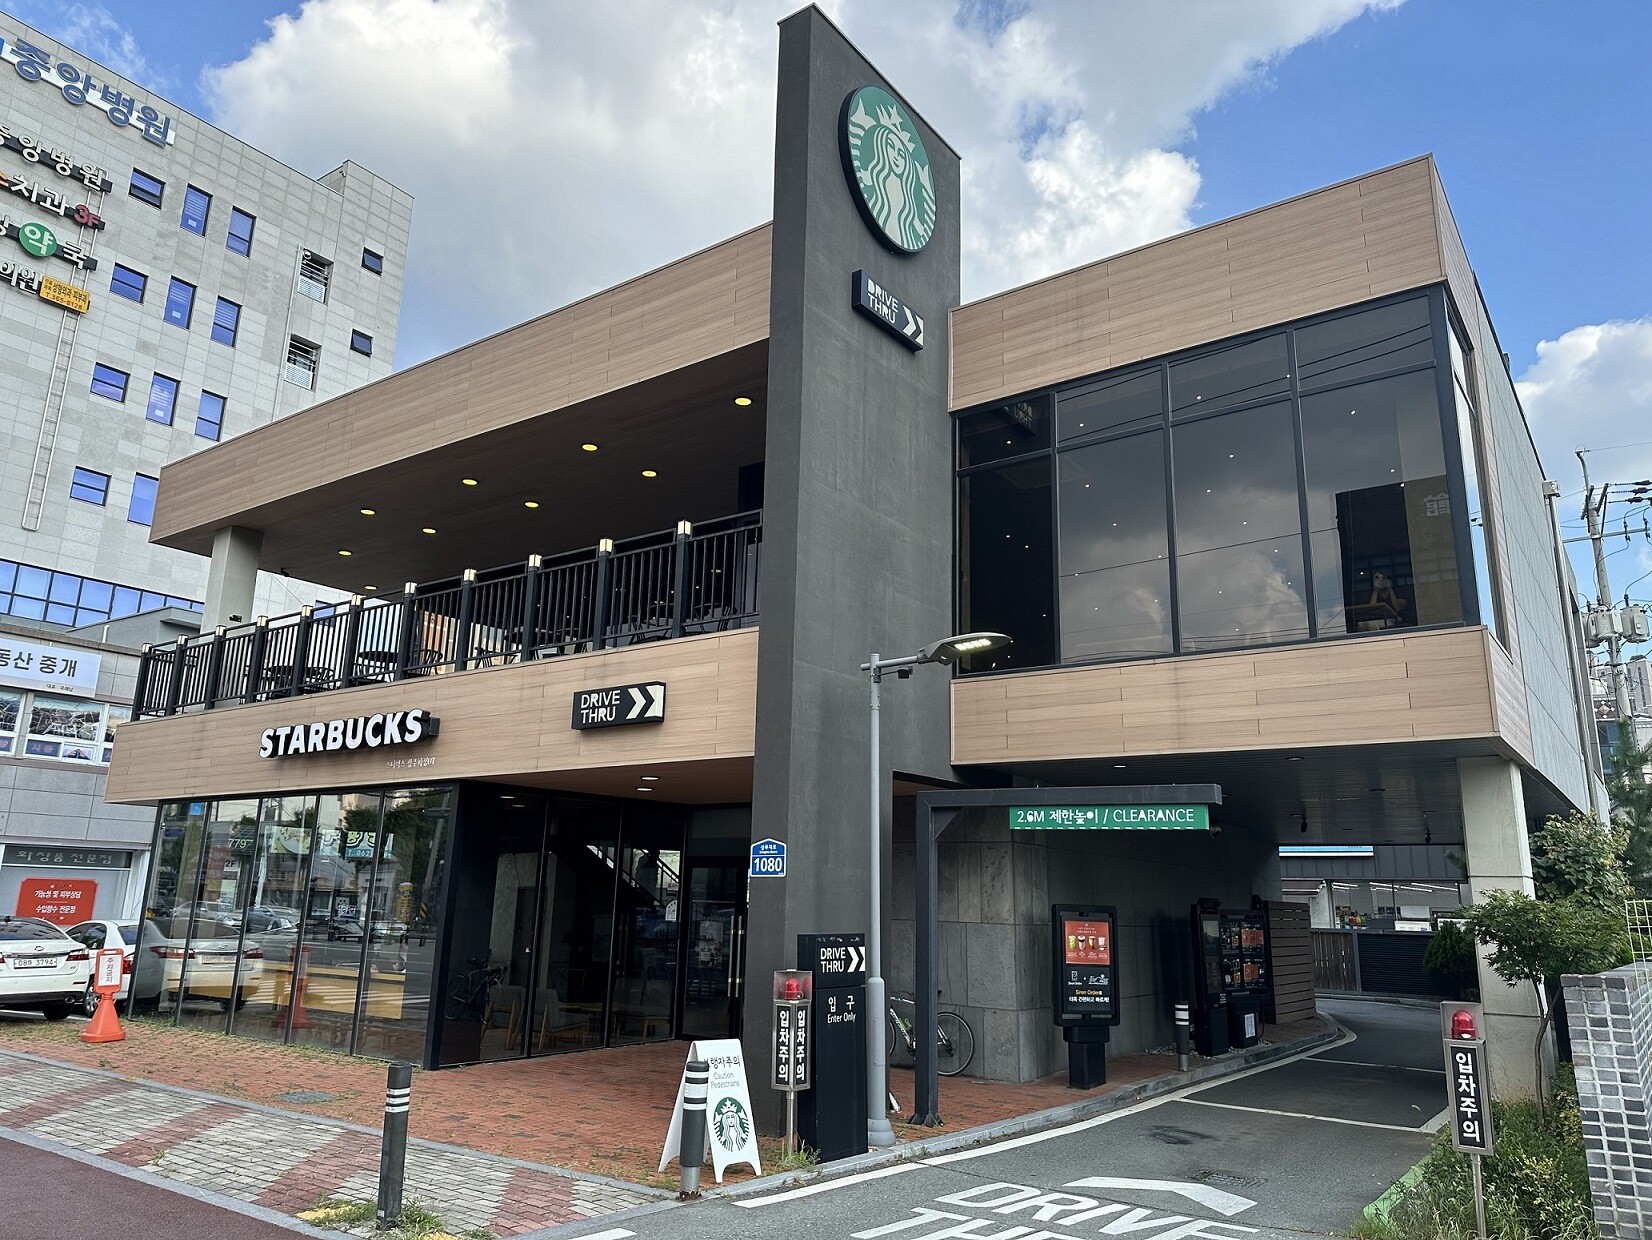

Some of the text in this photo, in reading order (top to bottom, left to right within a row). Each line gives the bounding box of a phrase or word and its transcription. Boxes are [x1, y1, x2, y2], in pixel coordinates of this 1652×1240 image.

[10, 37, 171, 148] 중앙병원
[74, 203, 101, 227] 3F
[867, 278, 899, 313] DRIVE
[867, 293, 896, 325] THRU
[39, 655, 78, 678] 중개
[579, 690, 621, 710] DRIVE
[579, 705, 617, 724] THRU
[258, 708, 424, 758] STARBUCKS
[1017, 810, 1045, 823] 2.6M
[1112, 808, 1194, 822] CLEARANCE
[17, 850, 113, 864] 화장품 전문점
[754, 857, 783, 872] 1080
[35, 958, 54, 967] 3794
[820, 946, 846, 960] DRIVE
[820, 960, 845, 974] THRU
[827, 1011, 857, 1024] Enter Only
[778, 1010, 790, 1082] 입차주의
[796, 1009, 806, 1081] 입차주의
[710, 1080, 740, 1089] Pedestrians
[713, 1071, 735, 1080] Caution
[1455, 1052, 1481, 1143] 입차주의
